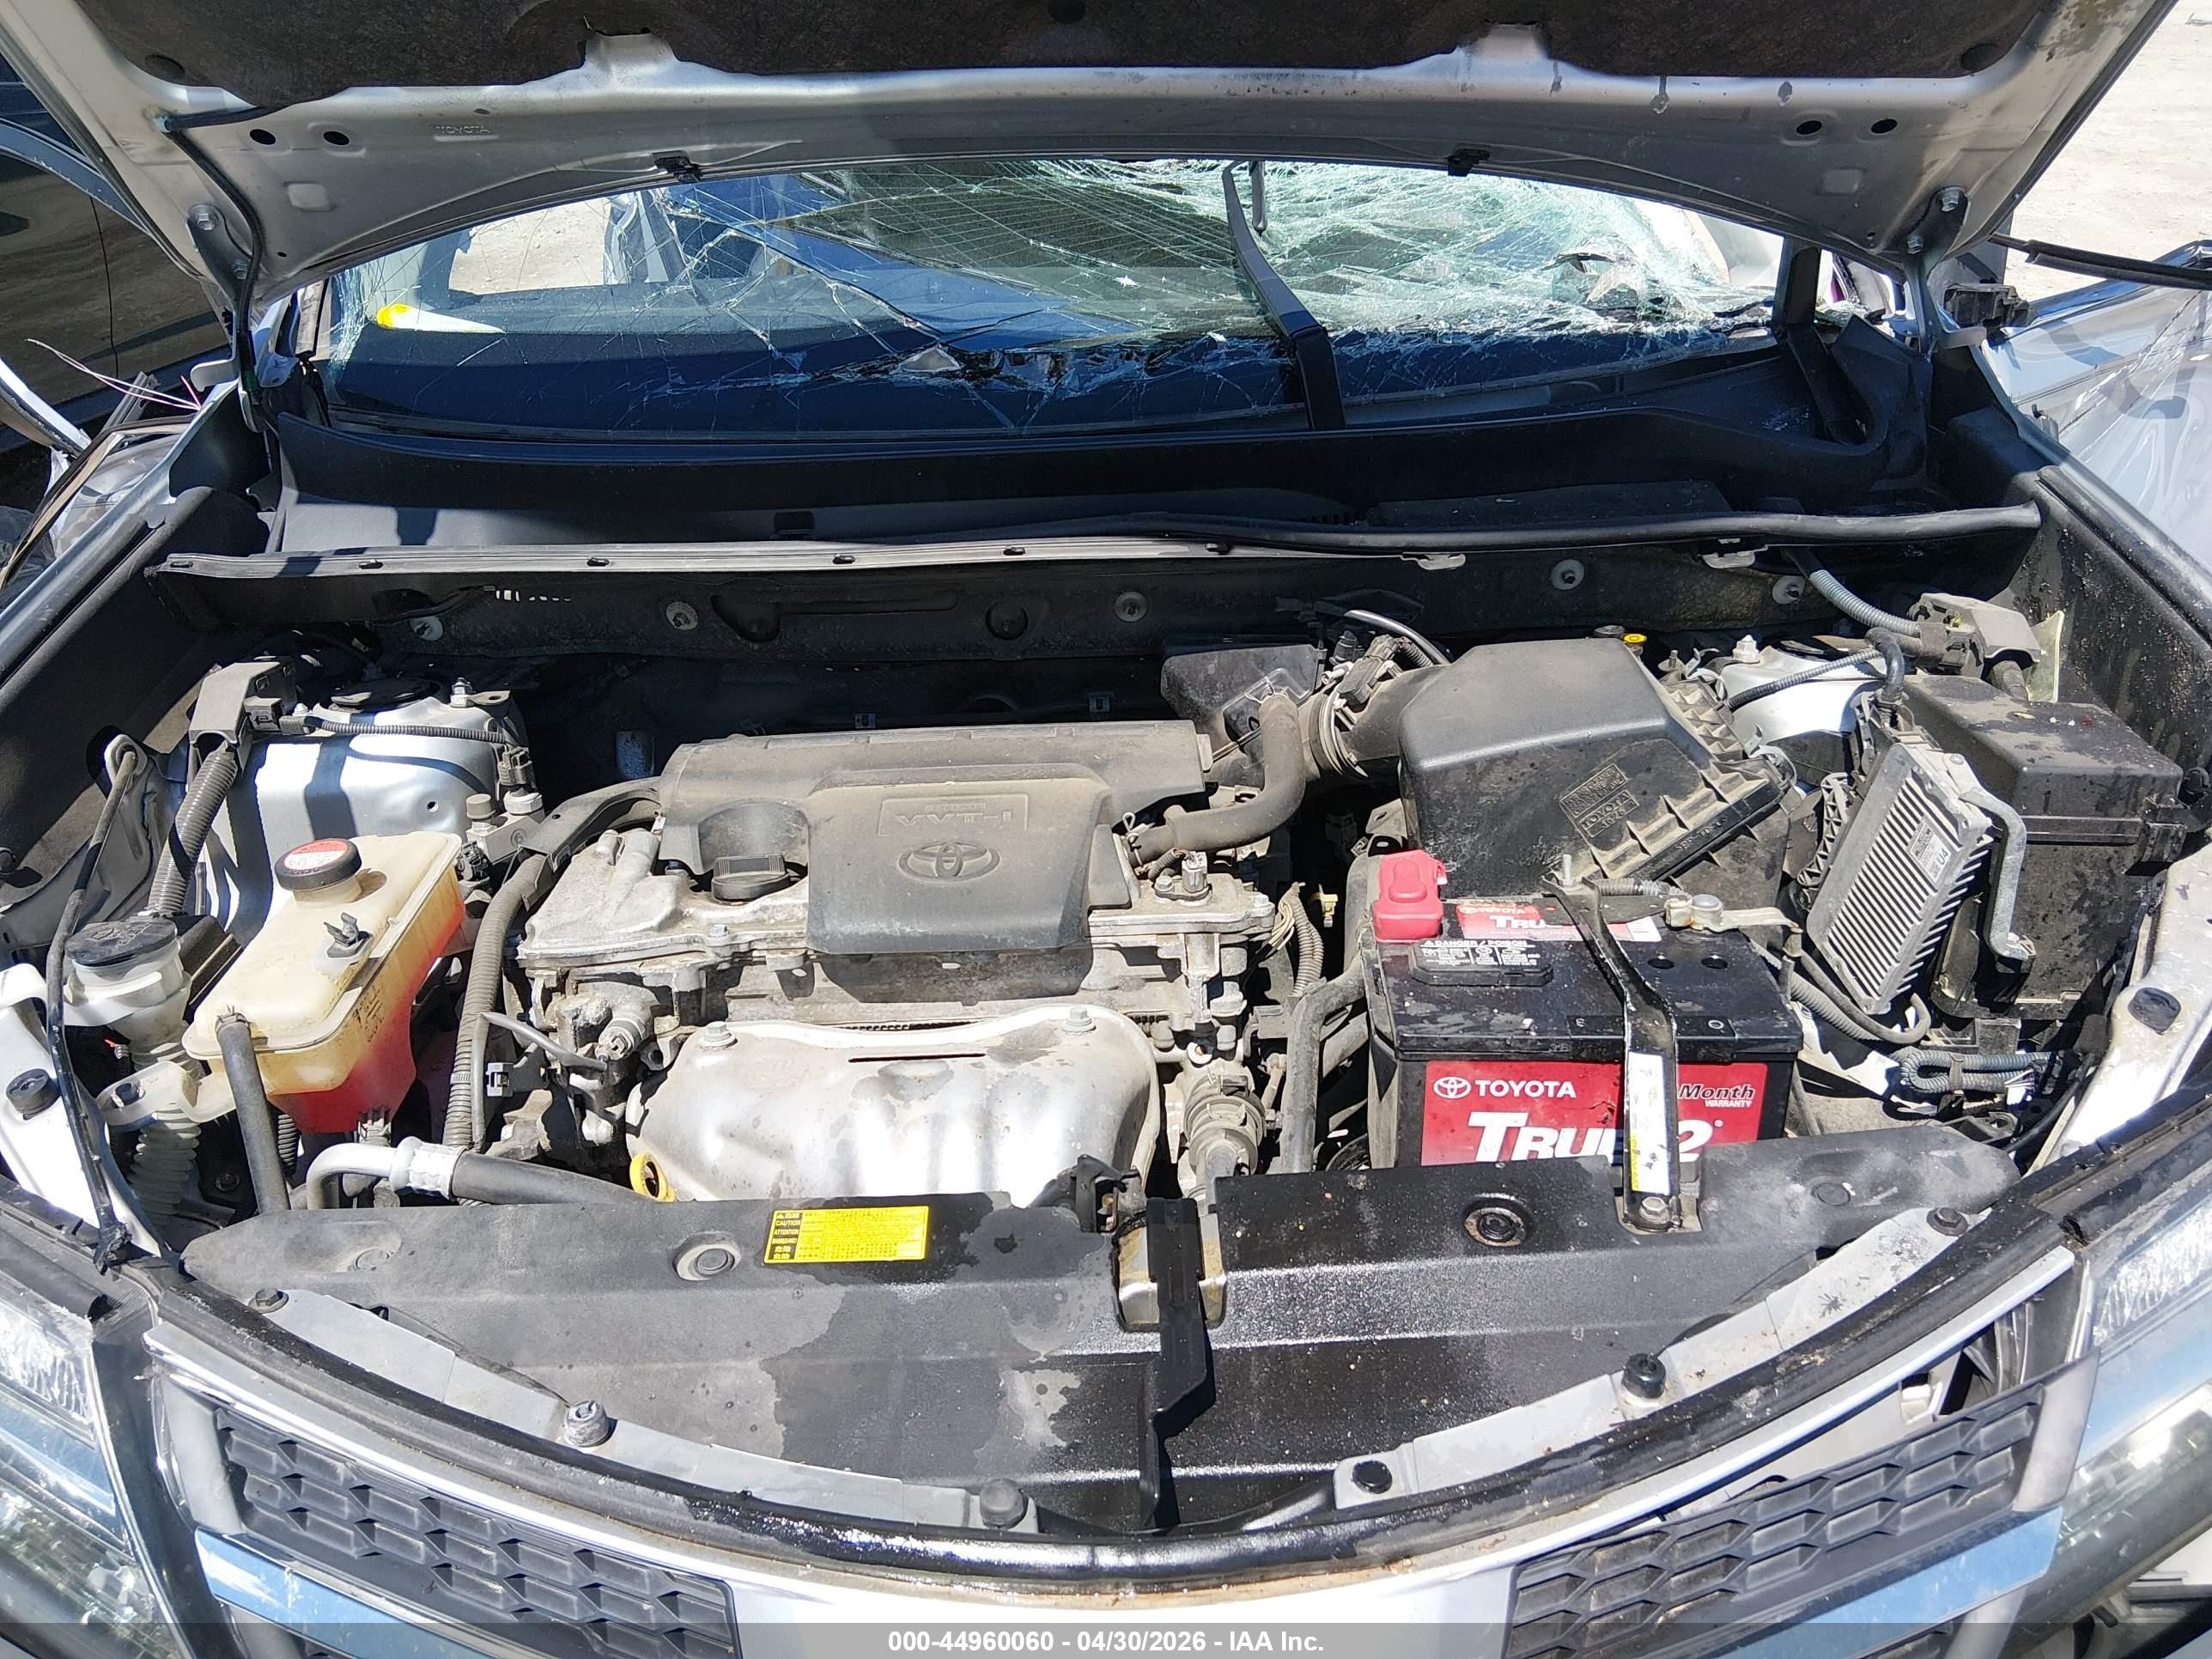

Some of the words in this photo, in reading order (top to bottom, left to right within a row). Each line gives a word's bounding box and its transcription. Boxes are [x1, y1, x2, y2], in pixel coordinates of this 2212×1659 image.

[1581, 792, 1629, 829] TOYOTA
[1474, 1079, 1577, 1099] TOYOTA
[1678, 1083, 1756, 1100] Month
[1705, 1099, 1753, 1109] WARRANTY
